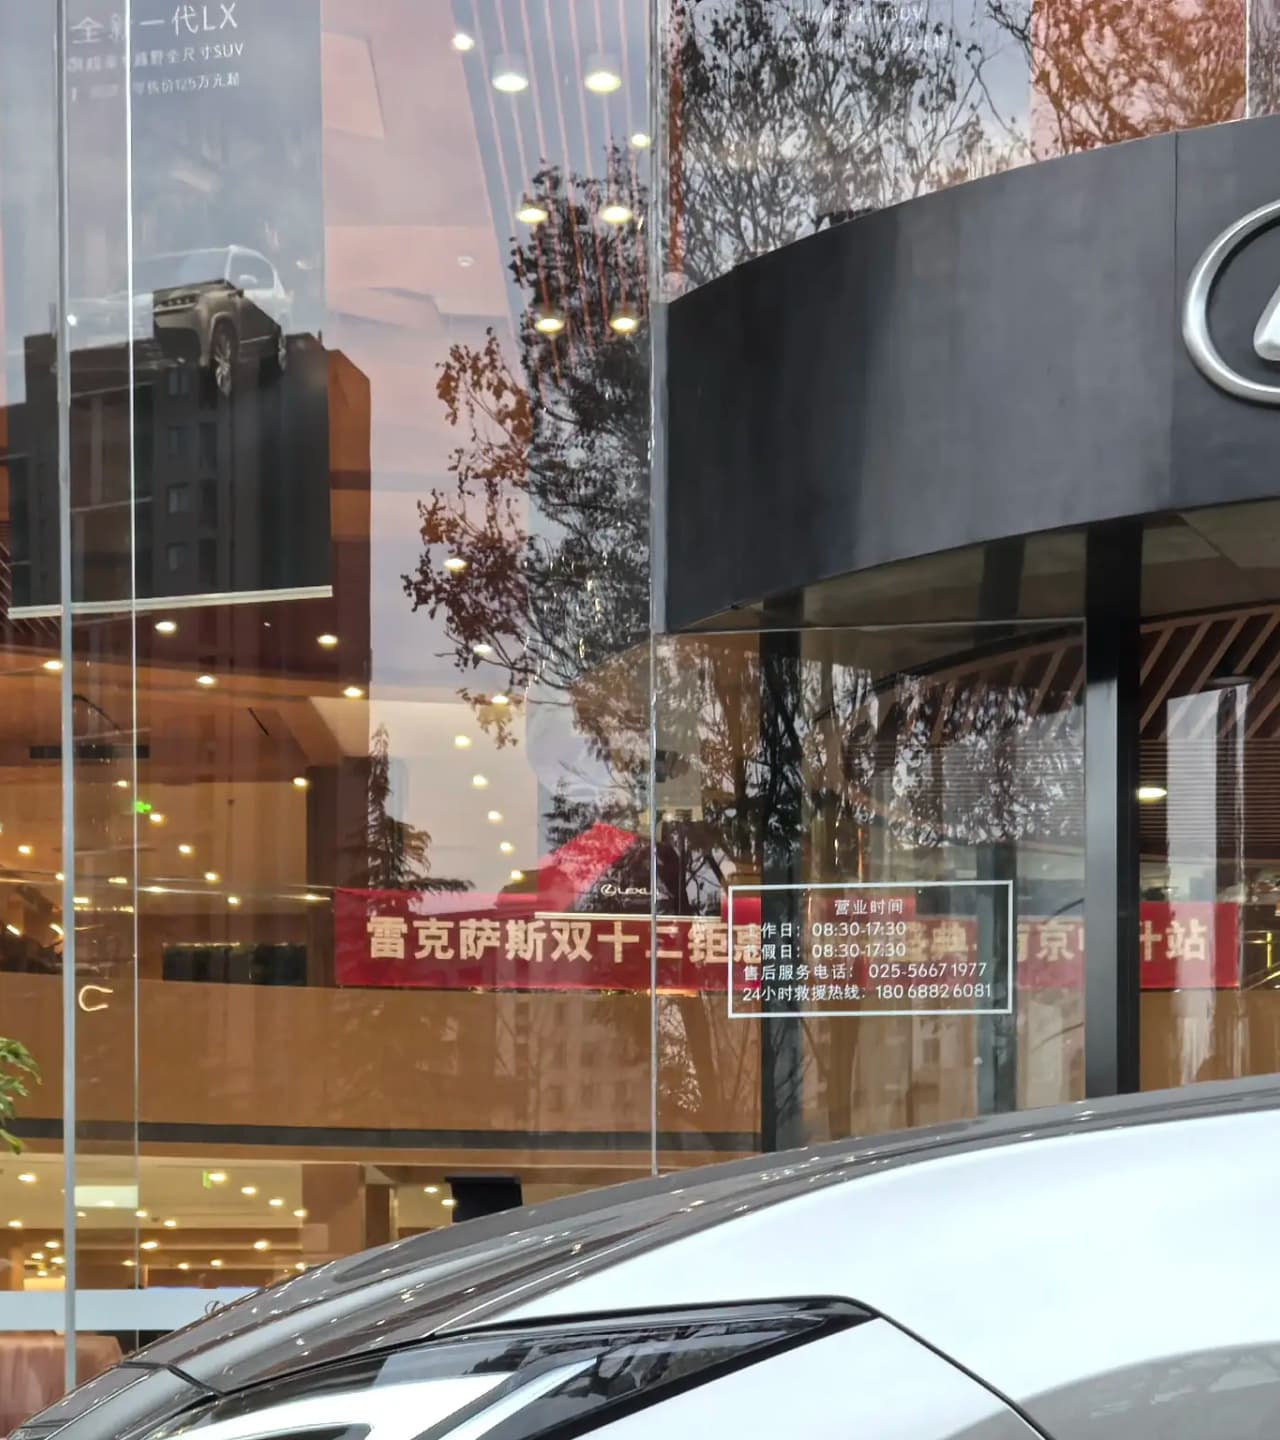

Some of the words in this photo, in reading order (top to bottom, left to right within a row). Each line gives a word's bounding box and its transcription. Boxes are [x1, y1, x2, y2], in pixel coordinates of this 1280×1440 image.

[834, 899, 903, 916] 营业时间
[812, 921, 907, 937] 08:30-17:30
[812, 943, 907, 958] 08:30-17:30
